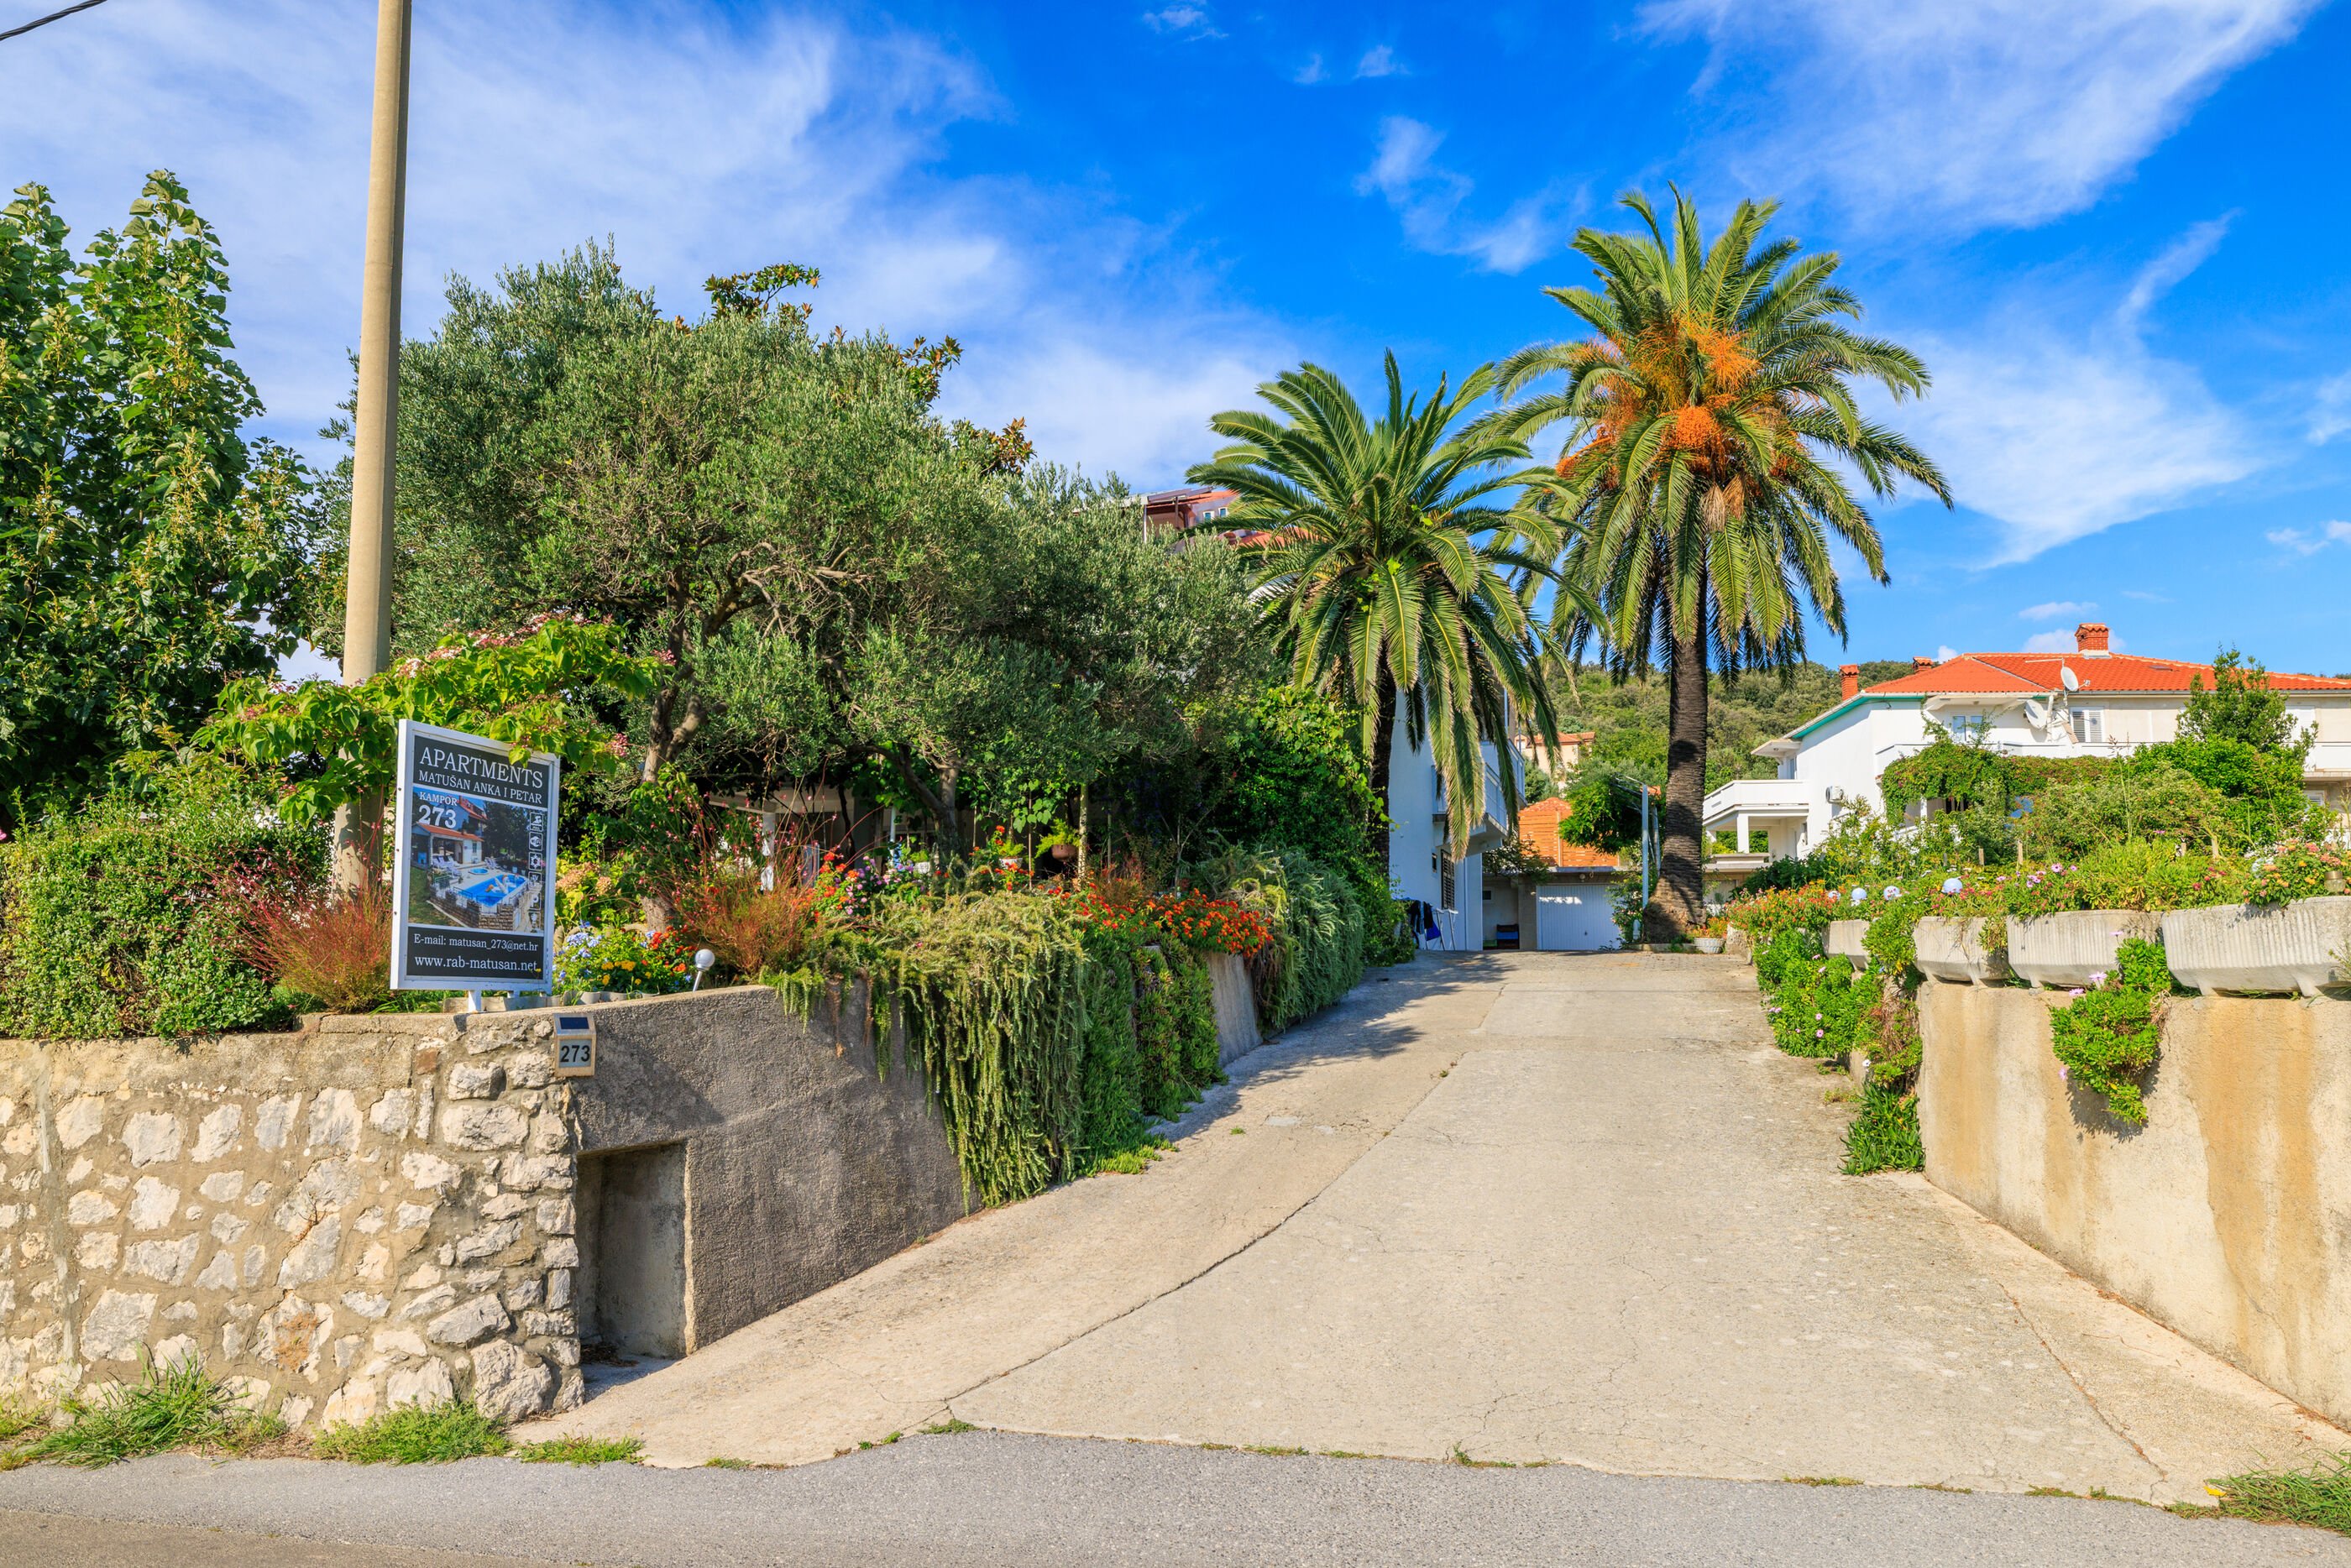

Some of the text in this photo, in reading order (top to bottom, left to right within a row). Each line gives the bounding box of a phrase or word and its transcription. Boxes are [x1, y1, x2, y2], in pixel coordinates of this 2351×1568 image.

[420, 747, 543, 789] APARTMENTS
[419, 770, 542, 804] MATUŠAN ANKA I PETAR
[420, 792, 458, 807] KAMPOR
[419, 805, 457, 828] 273
[414, 933, 538, 952] E-mail: matusan_273@net.hr
[415, 956, 537, 971] www.rab-matusan.net
[560, 1045, 590, 1063] 273
